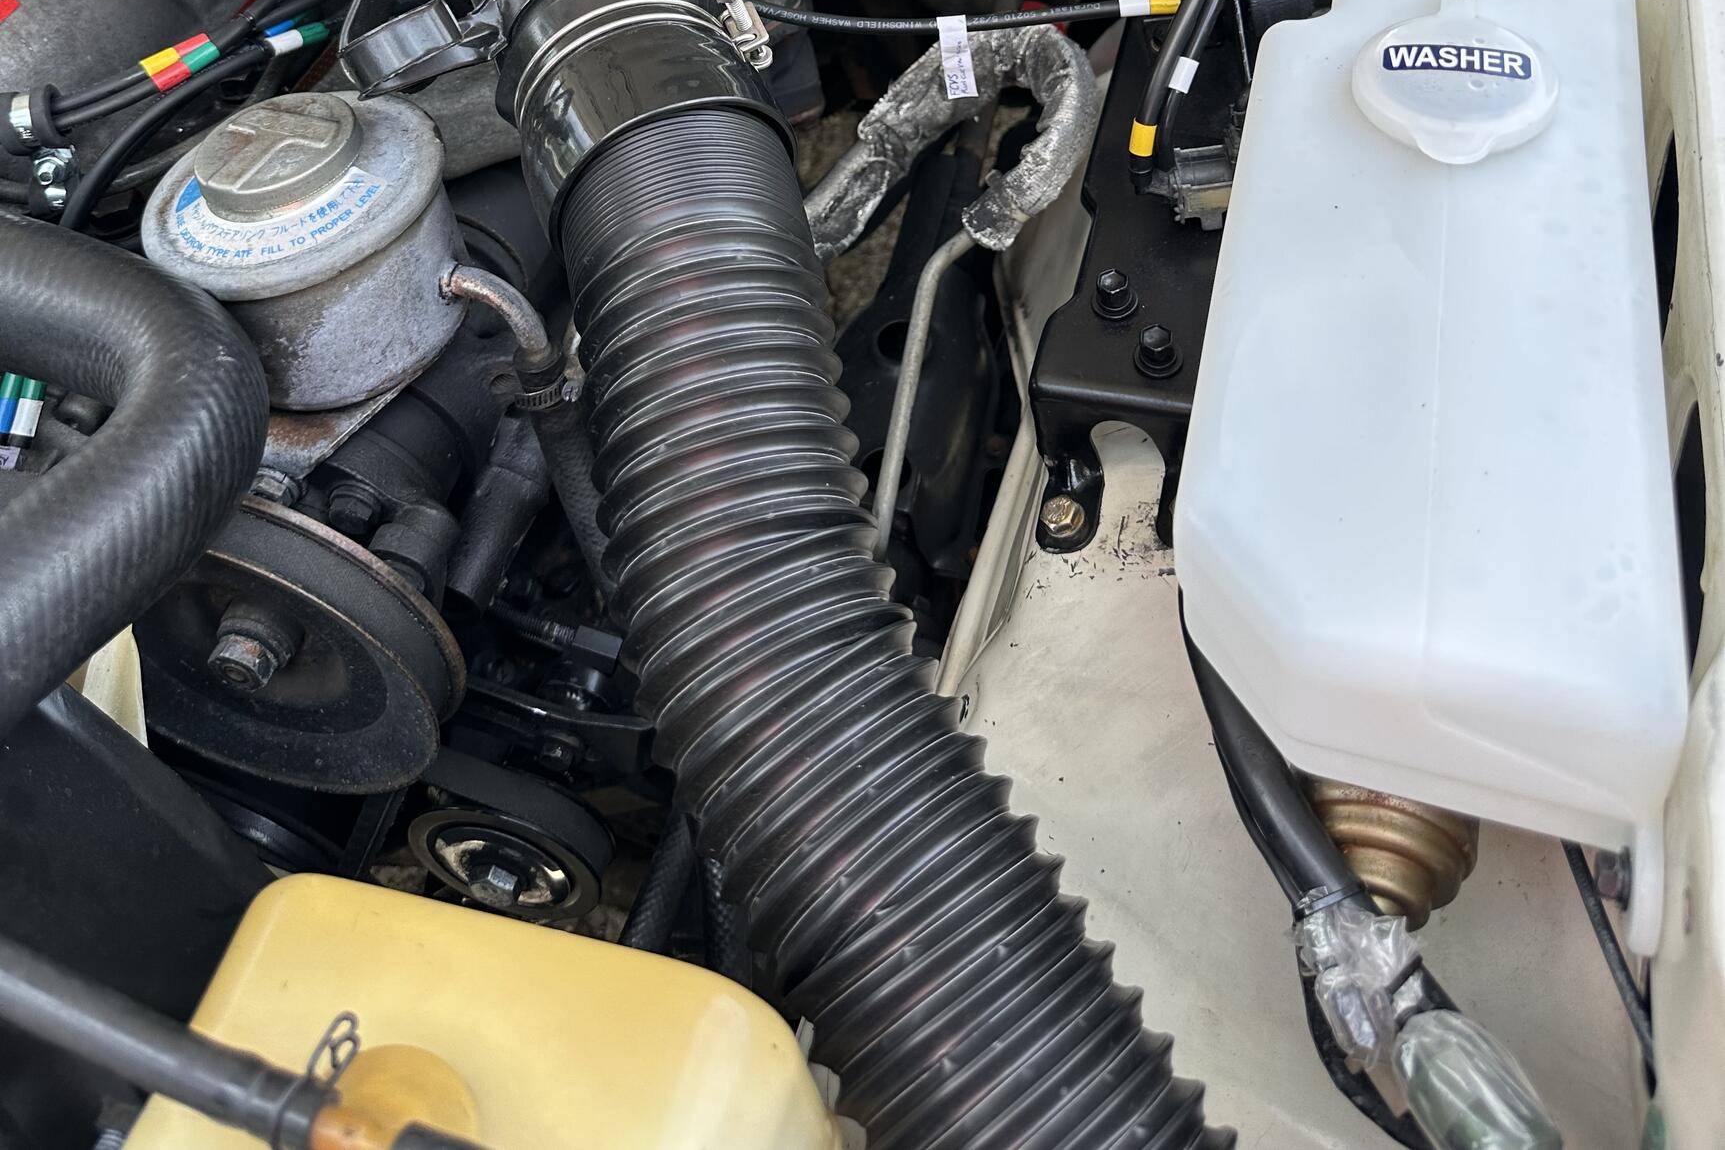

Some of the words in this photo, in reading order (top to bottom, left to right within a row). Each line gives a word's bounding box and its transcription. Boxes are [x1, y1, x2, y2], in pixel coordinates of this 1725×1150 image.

[812, 15, 851, 27] WASHER
[1003, 11, 1037, 22] 50210
[856, 19, 922, 29] WINDSHIELD
[1388, 45, 1526, 77] WASHER
[205, 245, 230, 258] TYPE
[232, 248, 254, 259] ATF
[260, 244, 284, 256] FILL
[288, 236, 306, 248] TO
[309, 208, 354, 238] PROPER
[354, 183, 382, 208] LEVEL
